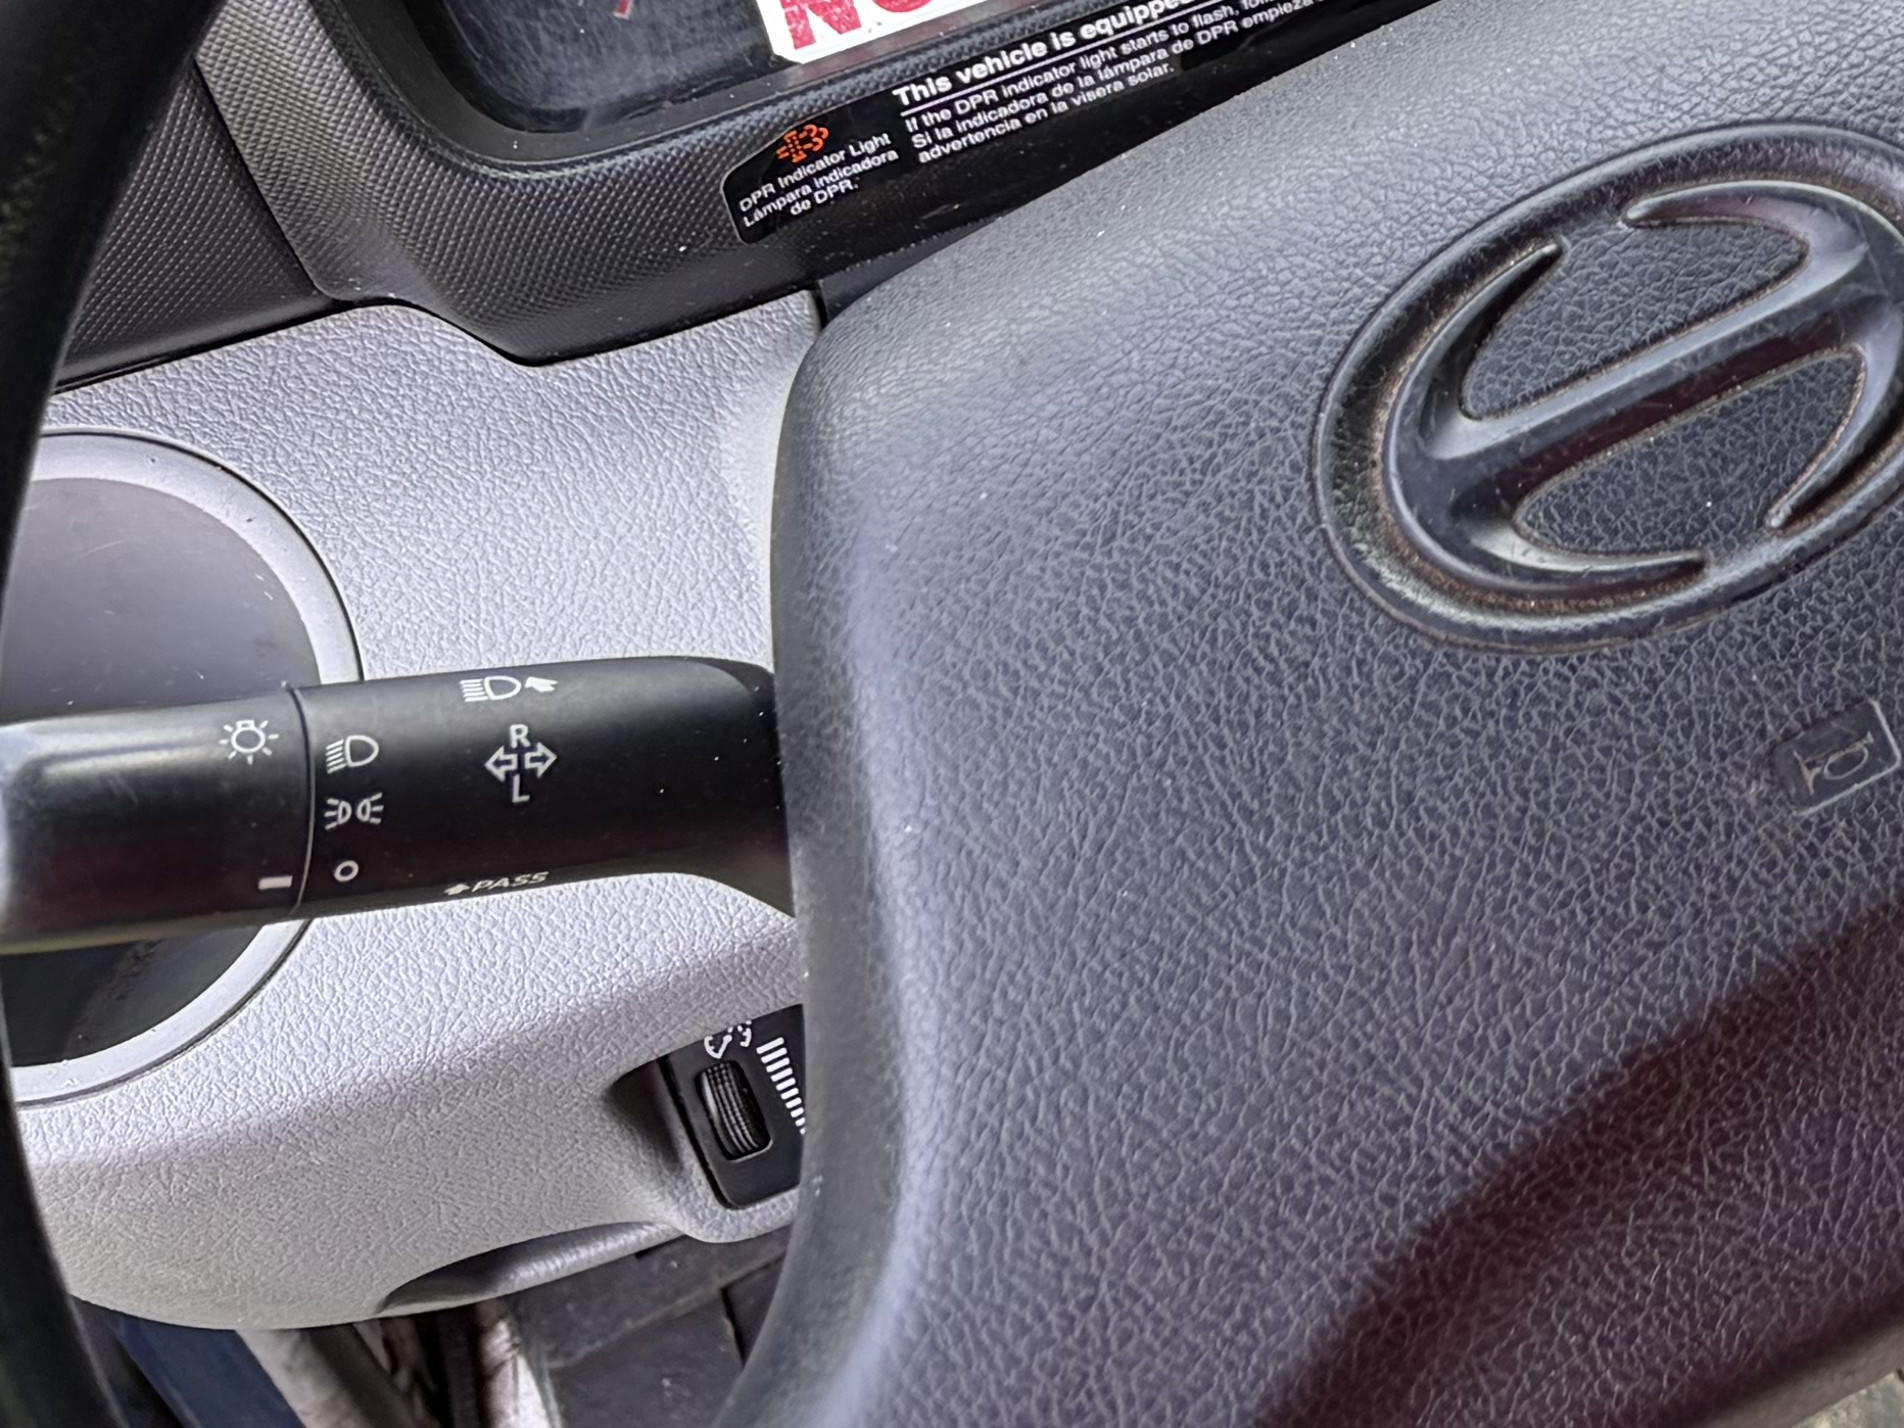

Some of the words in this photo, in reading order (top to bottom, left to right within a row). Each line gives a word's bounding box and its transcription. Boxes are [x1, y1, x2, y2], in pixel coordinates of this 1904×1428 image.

[892, 77, 952, 105] This
[956, 42, 1047, 83] vehicle
[1050, 32, 1076, 50] is
[906, 117, 918, 132] If
[922, 109, 951, 126] the
[955, 89, 998, 114] DPR
[1002, 63, 1075, 97] indicator
[1080, 47, 1117, 70] light
[1120, 30, 1169, 54] starts
[1170, 23, 1189, 35] to
[912, 132, 932, 148] Si
[935, 127, 953, 140] la
[956, 93, 1048, 132] indicadora
[1052, 83, 1074, 97] de
[1077, 76, 1095, 88] la
[1171, 39, 1193, 54] de
[1196, 20, 1238, 44] DPR
[919, 119, 1021, 163] advertencia
[1025, 109, 1048, 123] en
[1051, 101, 1068, 113] la
[1071, 81, 1124, 105] visera
[1128, 64, 1173, 86] solar.
[739, 183, 776, 213] DPR
[849, 133, 892, 157] Light
[790, 200, 811, 216] de
[510, 723, 530, 748] R
[511, 774, 531, 804] L
[471, 872, 551, 892] PASS
